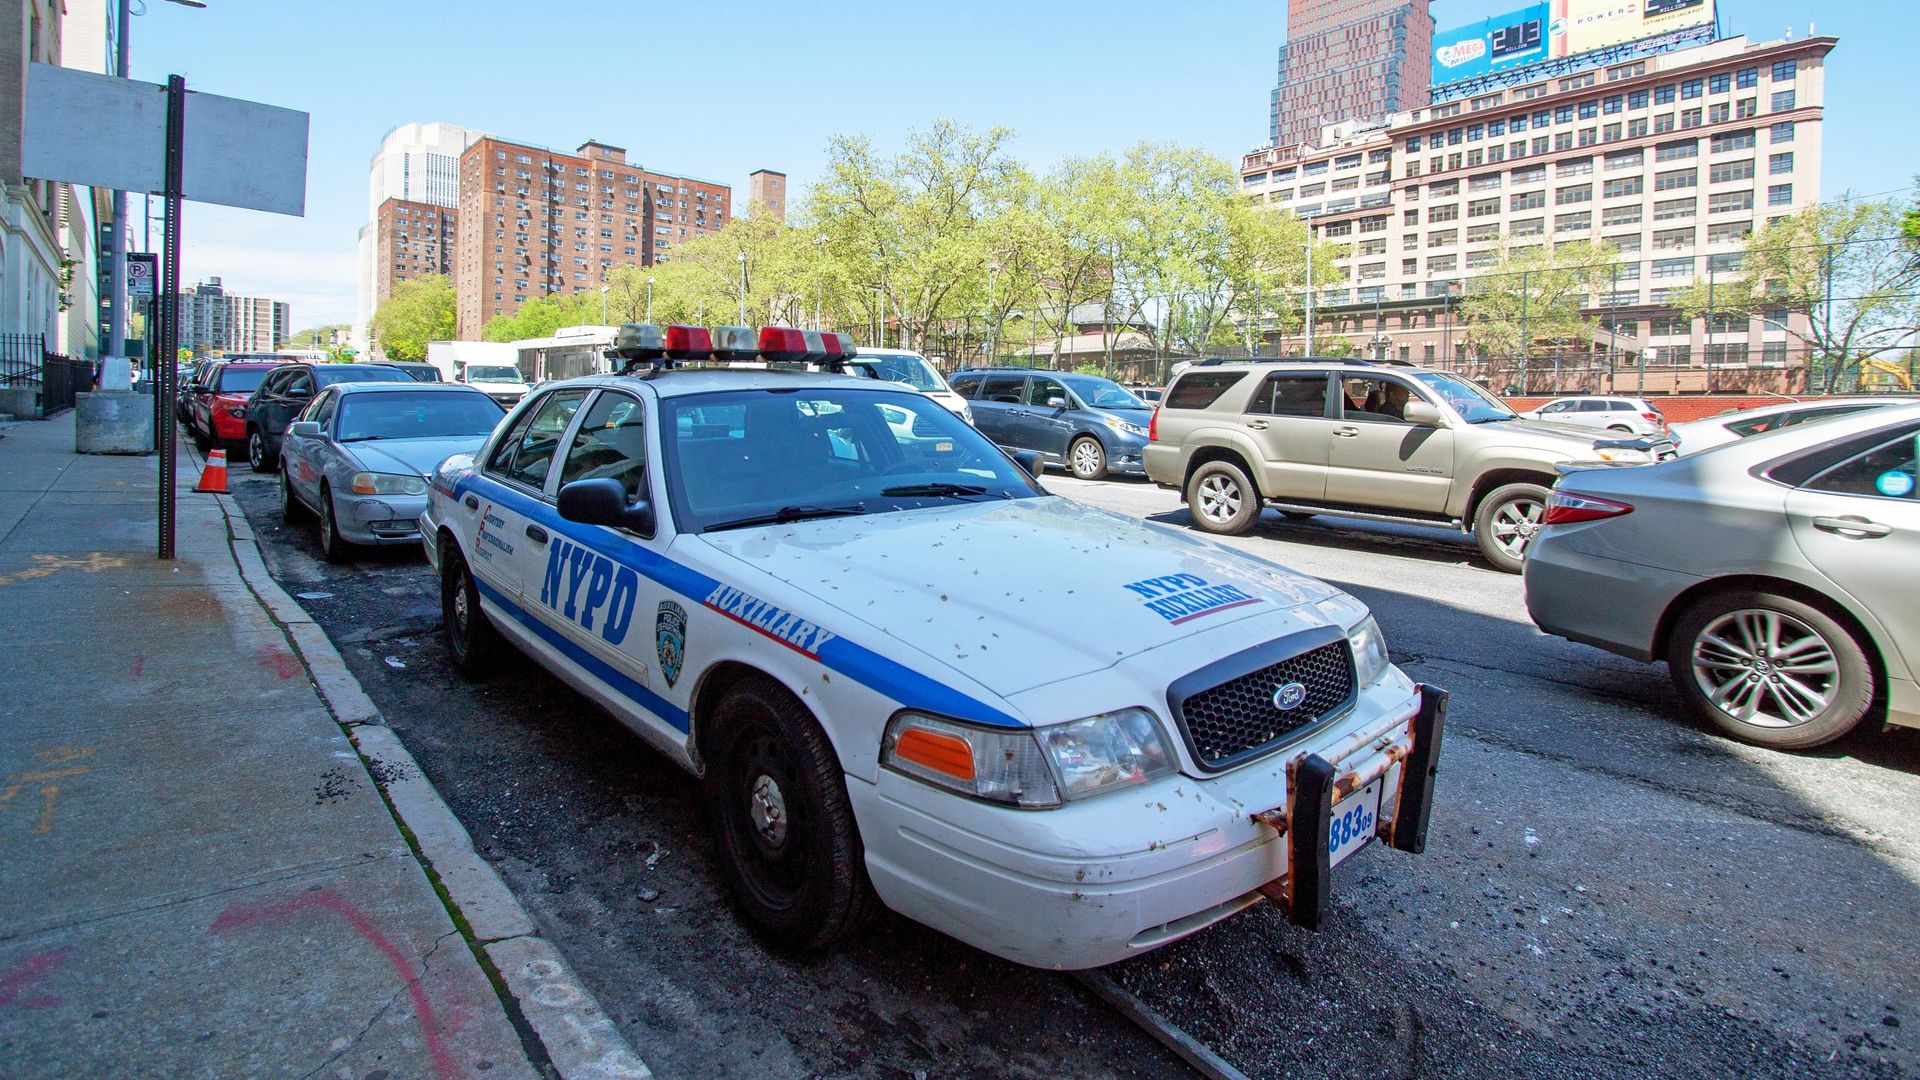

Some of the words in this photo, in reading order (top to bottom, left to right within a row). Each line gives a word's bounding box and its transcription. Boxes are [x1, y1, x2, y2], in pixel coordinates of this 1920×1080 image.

[1577, 8, 1625, 24] POWER
[1643, 14, 1676, 26] ESTIMATED
[1677, 7, 1704, 20] JACKPOT
[1453, 42, 1484, 58] MEGA
[541, 536, 638, 646] NYPD
[1123, 572, 1209, 600] NYPD
[659, 600, 688, 624] AUXILIARY
[1144, 584, 1254, 621] AUXILIARY
[664, 613, 681, 629] POLICE
[704, 582, 836, 655] AUXILIARY
[1282, 686, 1300, 705] Ford
